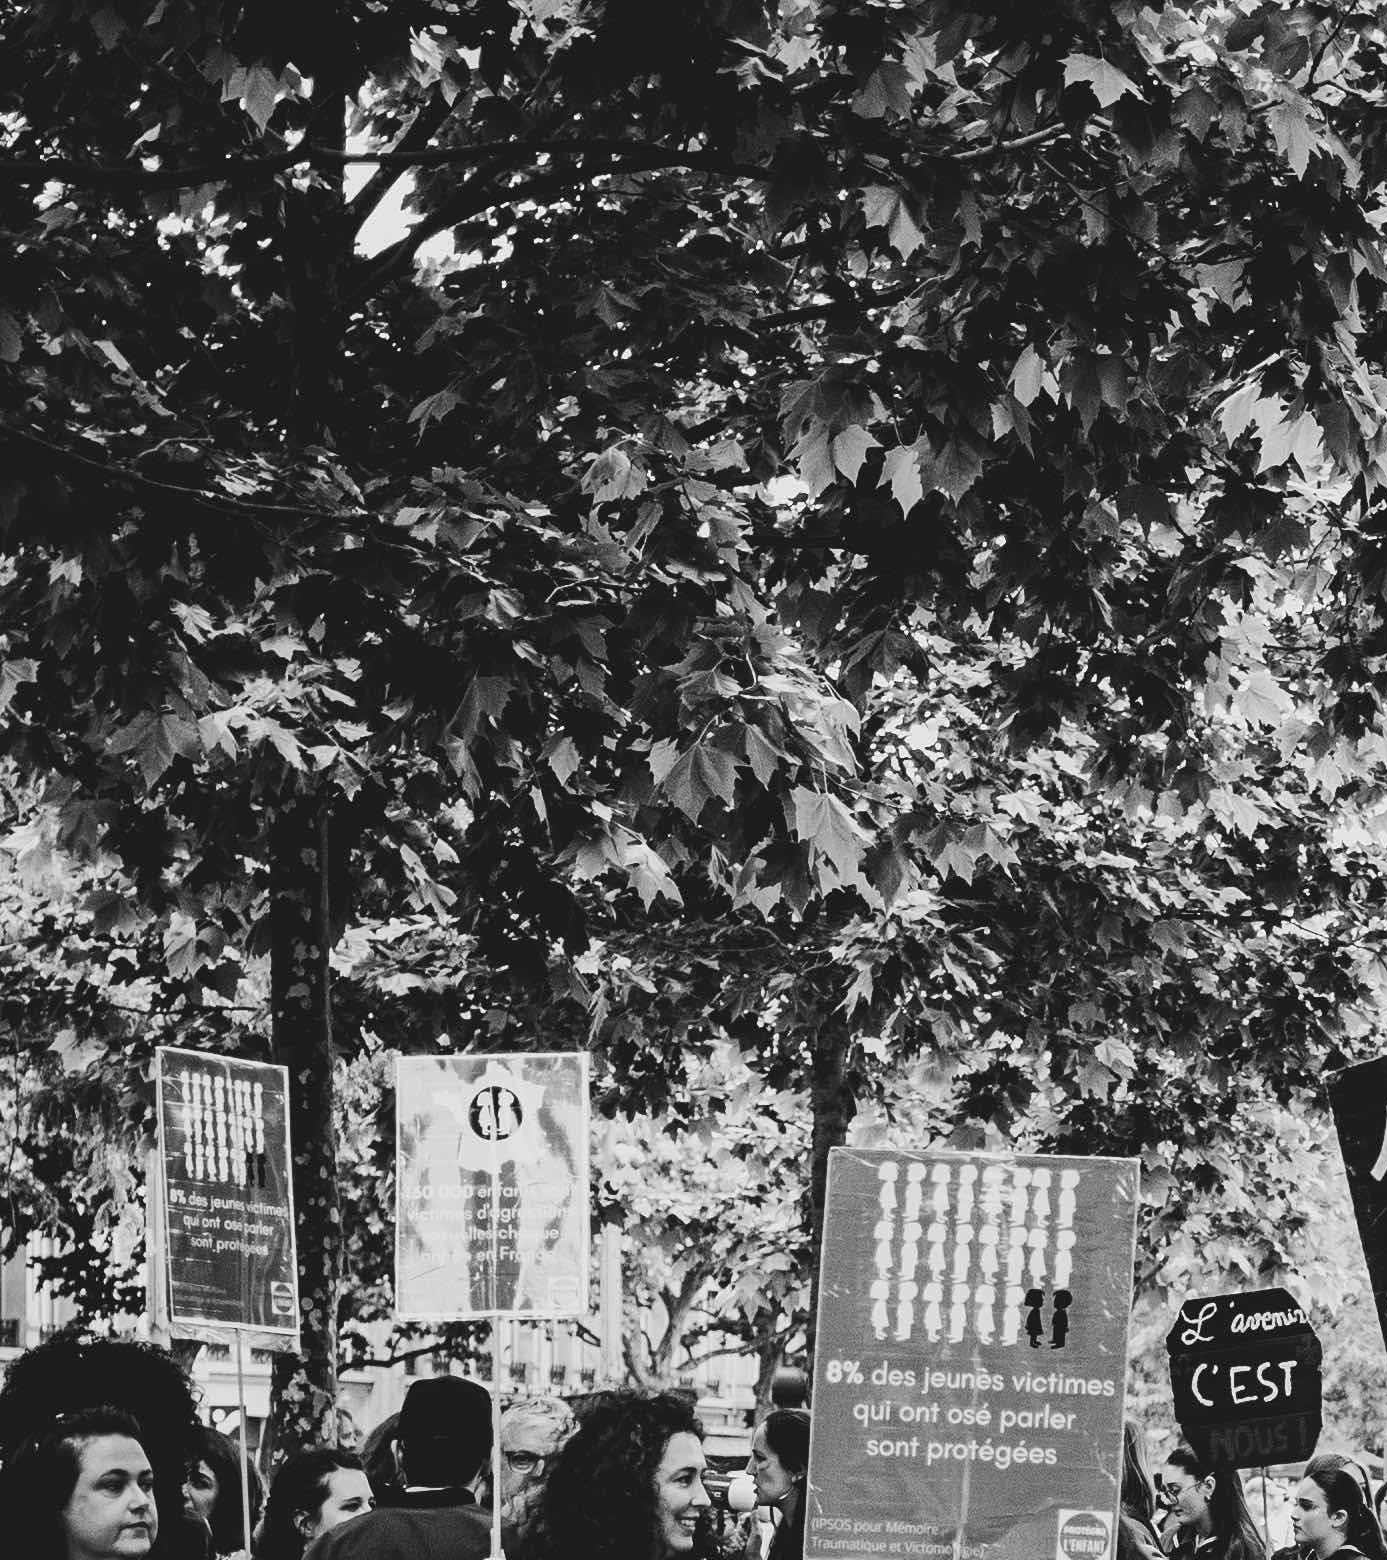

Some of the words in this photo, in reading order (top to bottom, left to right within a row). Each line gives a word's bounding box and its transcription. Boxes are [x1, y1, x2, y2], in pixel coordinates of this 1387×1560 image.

[170, 1188, 187, 1205] 8%
[188, 1191, 208, 1207] des
[210, 1195, 245, 1212] jeunes
[183, 1215, 200, 1229] qui
[202, 1216, 221, 1229] ont
[243, 1220, 274, 1236] parler
[191, 1233, 213, 1248] sont
[1181, 1302, 1308, 1345] L'avenir
[826, 1360, 864, 1385] 8%
[871, 1361, 916, 1387] des
[921, 1367, 1004, 1395] jeunes
[1012, 1372, 1115, 1397] victimes
[1192, 1360, 1298, 1407] C'EST
[853, 1400, 892, 1428] qui
[899, 1402, 940, 1424] ont
[947, 1404, 992, 1426] osé
[1000, 1404, 1077, 1434] parler
[866, 1437, 919, 1458] sont
[927, 1438, 1058, 1470] protégées
[854, 1521, 883, 1535] pour
[886, 1519, 939, 1536] Mémoire
[811, 1536, 887, 1553] Traumatique
[889, 1539, 900, 1552] et
[1063, 1538, 1106, 1553] L'ENFANT
